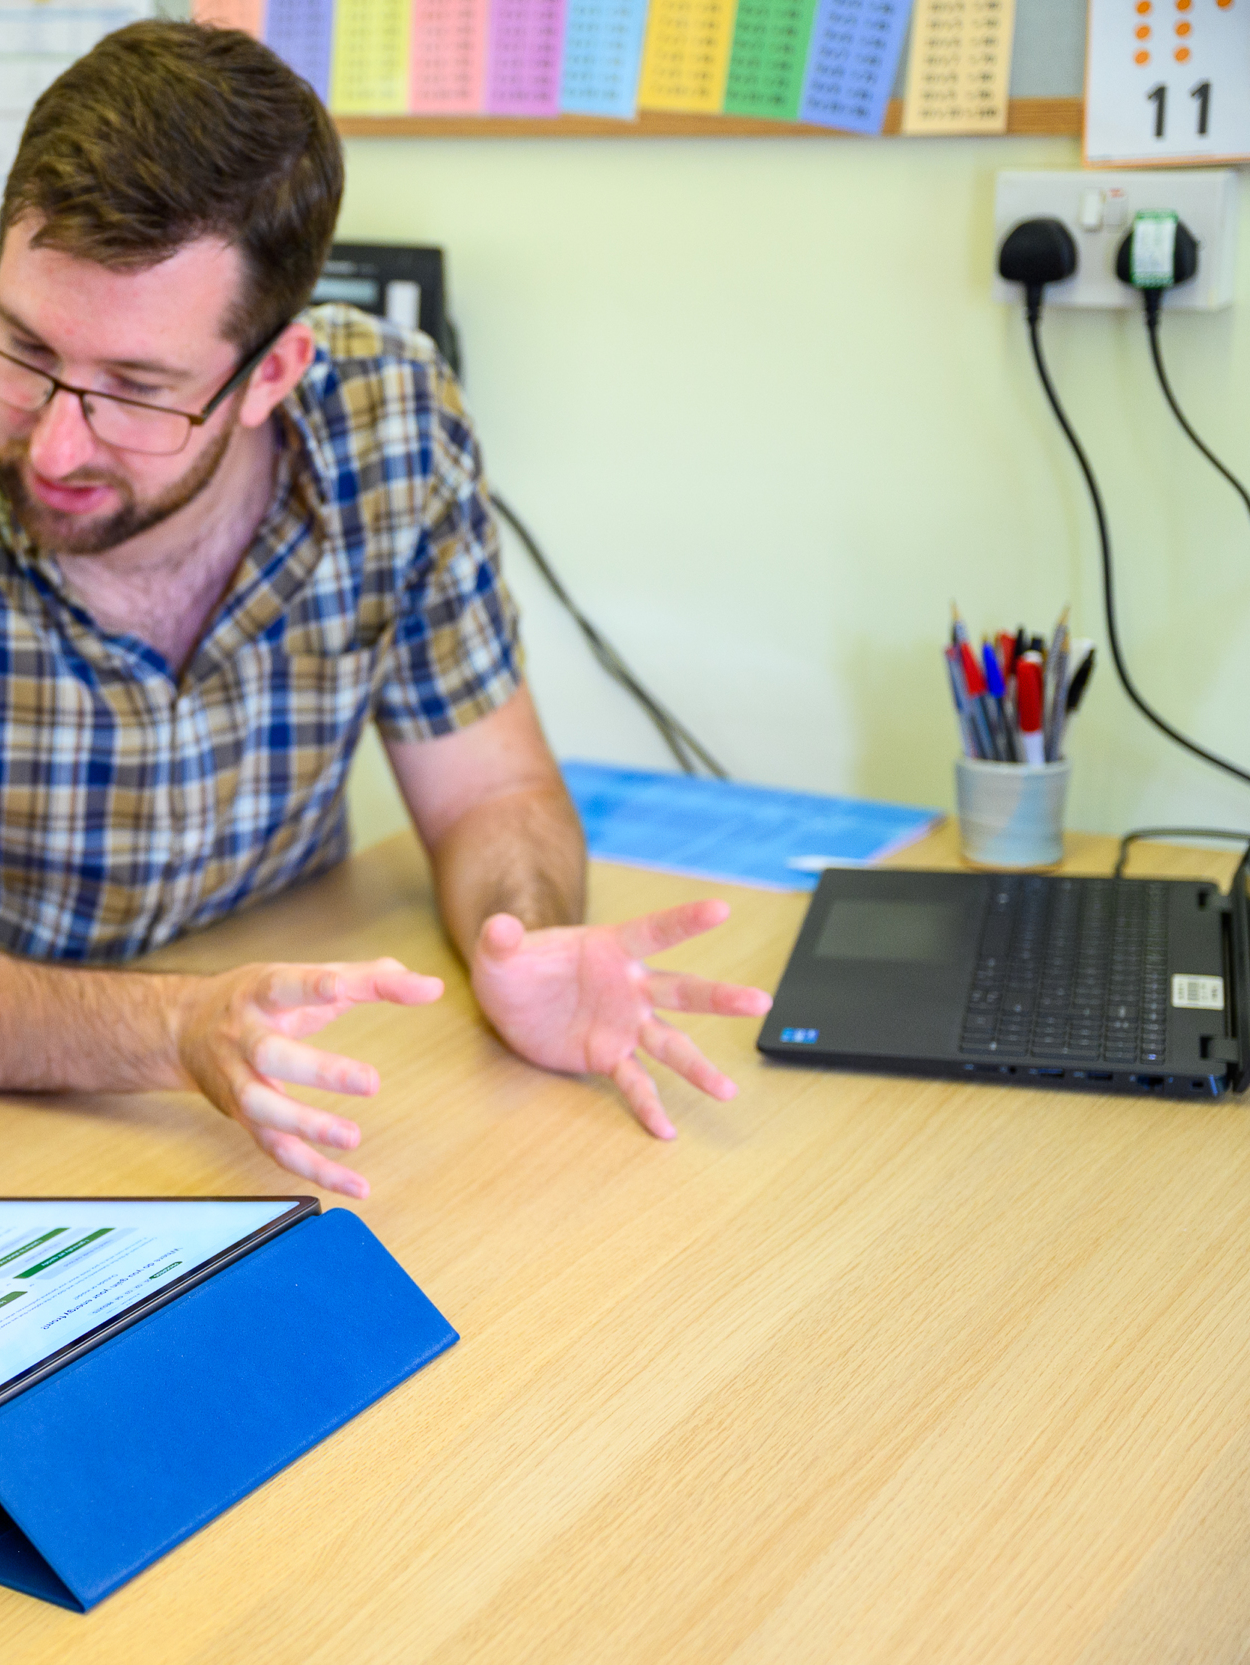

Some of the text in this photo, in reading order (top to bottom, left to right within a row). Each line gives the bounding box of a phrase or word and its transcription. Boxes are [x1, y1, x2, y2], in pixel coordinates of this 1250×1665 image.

[1146, 79, 1212, 138] 11
[154, 1248, 182, 1262] Where
[128, 1269, 141, 1278] you
[110, 1278, 128, 1288] gain
[94, 1288, 108, 1299] your
[64, 1299, 92, 1316] energy
[40, 1314, 68, 1330] from?
